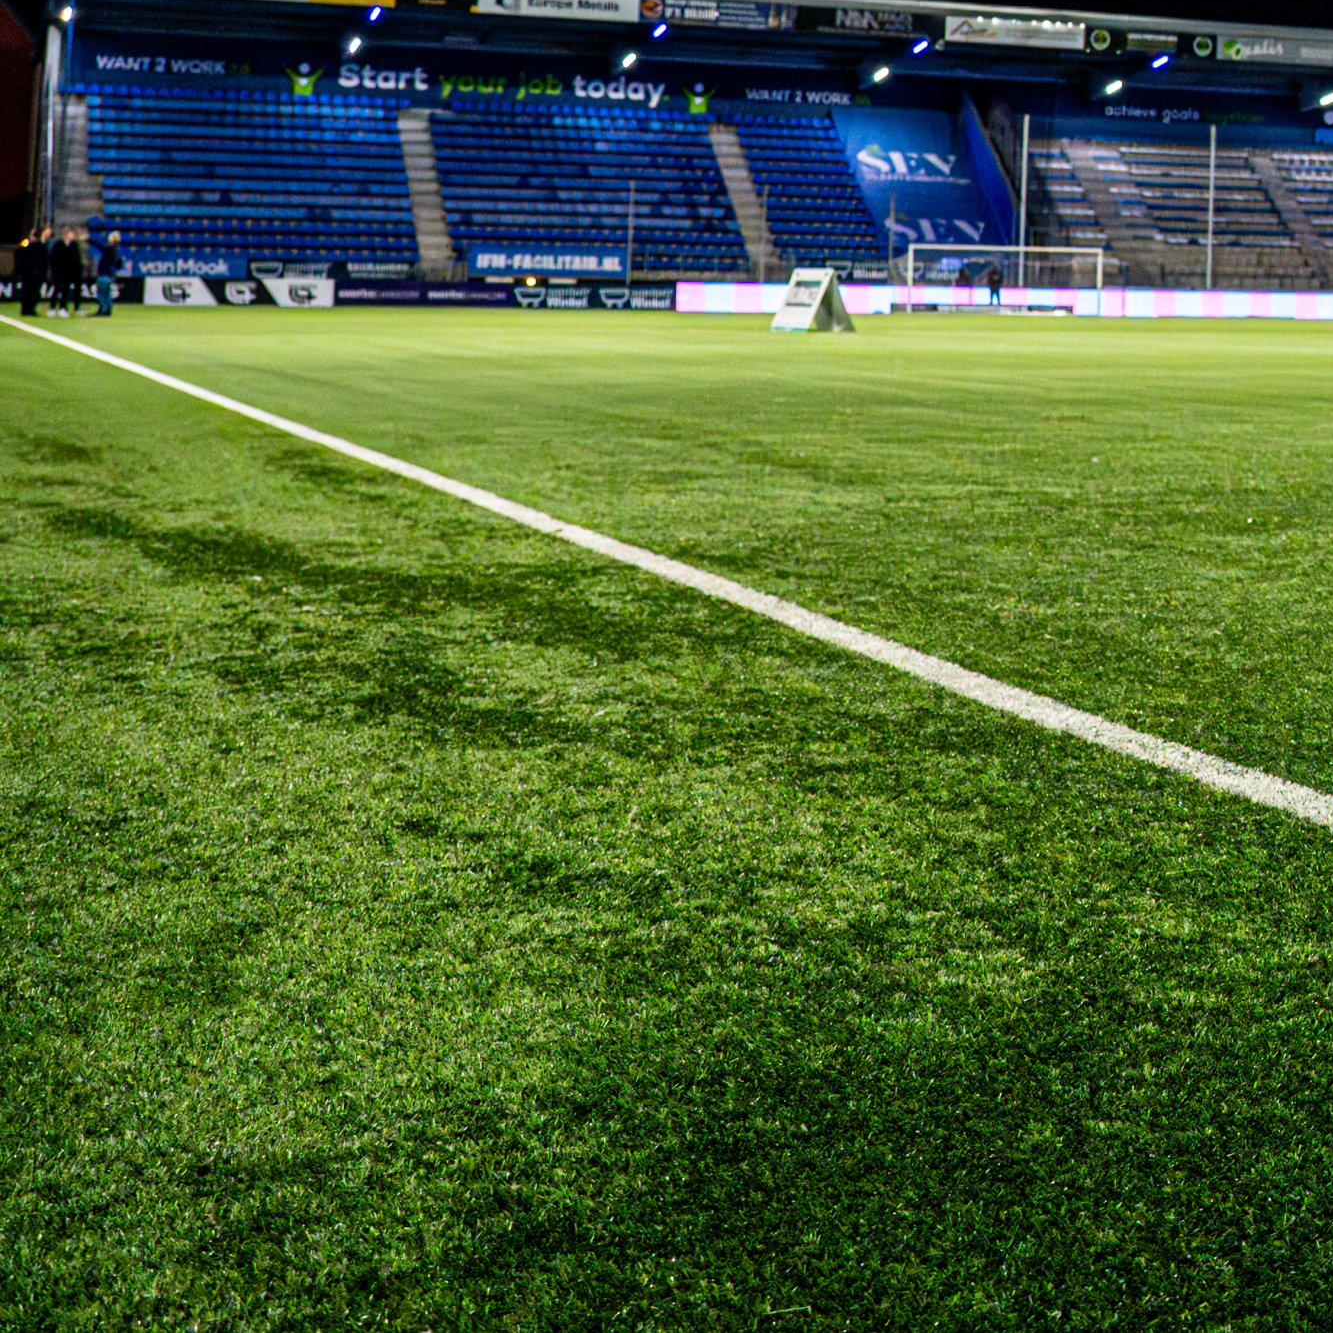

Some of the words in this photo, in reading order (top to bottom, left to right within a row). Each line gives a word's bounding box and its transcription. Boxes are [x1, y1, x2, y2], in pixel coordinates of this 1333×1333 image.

[96, 54, 151, 71] WANT
[154, 57, 167, 73] 2
[170, 59, 226, 75] WORK
[337, 63, 429, 91] Start
[439, 72, 508, 101] your
[514, 70, 563, 101] job
[745, 88, 791, 104] WANT
[795, 90, 804, 104] 2
[806, 90, 852, 106] WORK
[1104, 104, 1158, 119] achieve
[1161, 107, 1201, 124] goals
